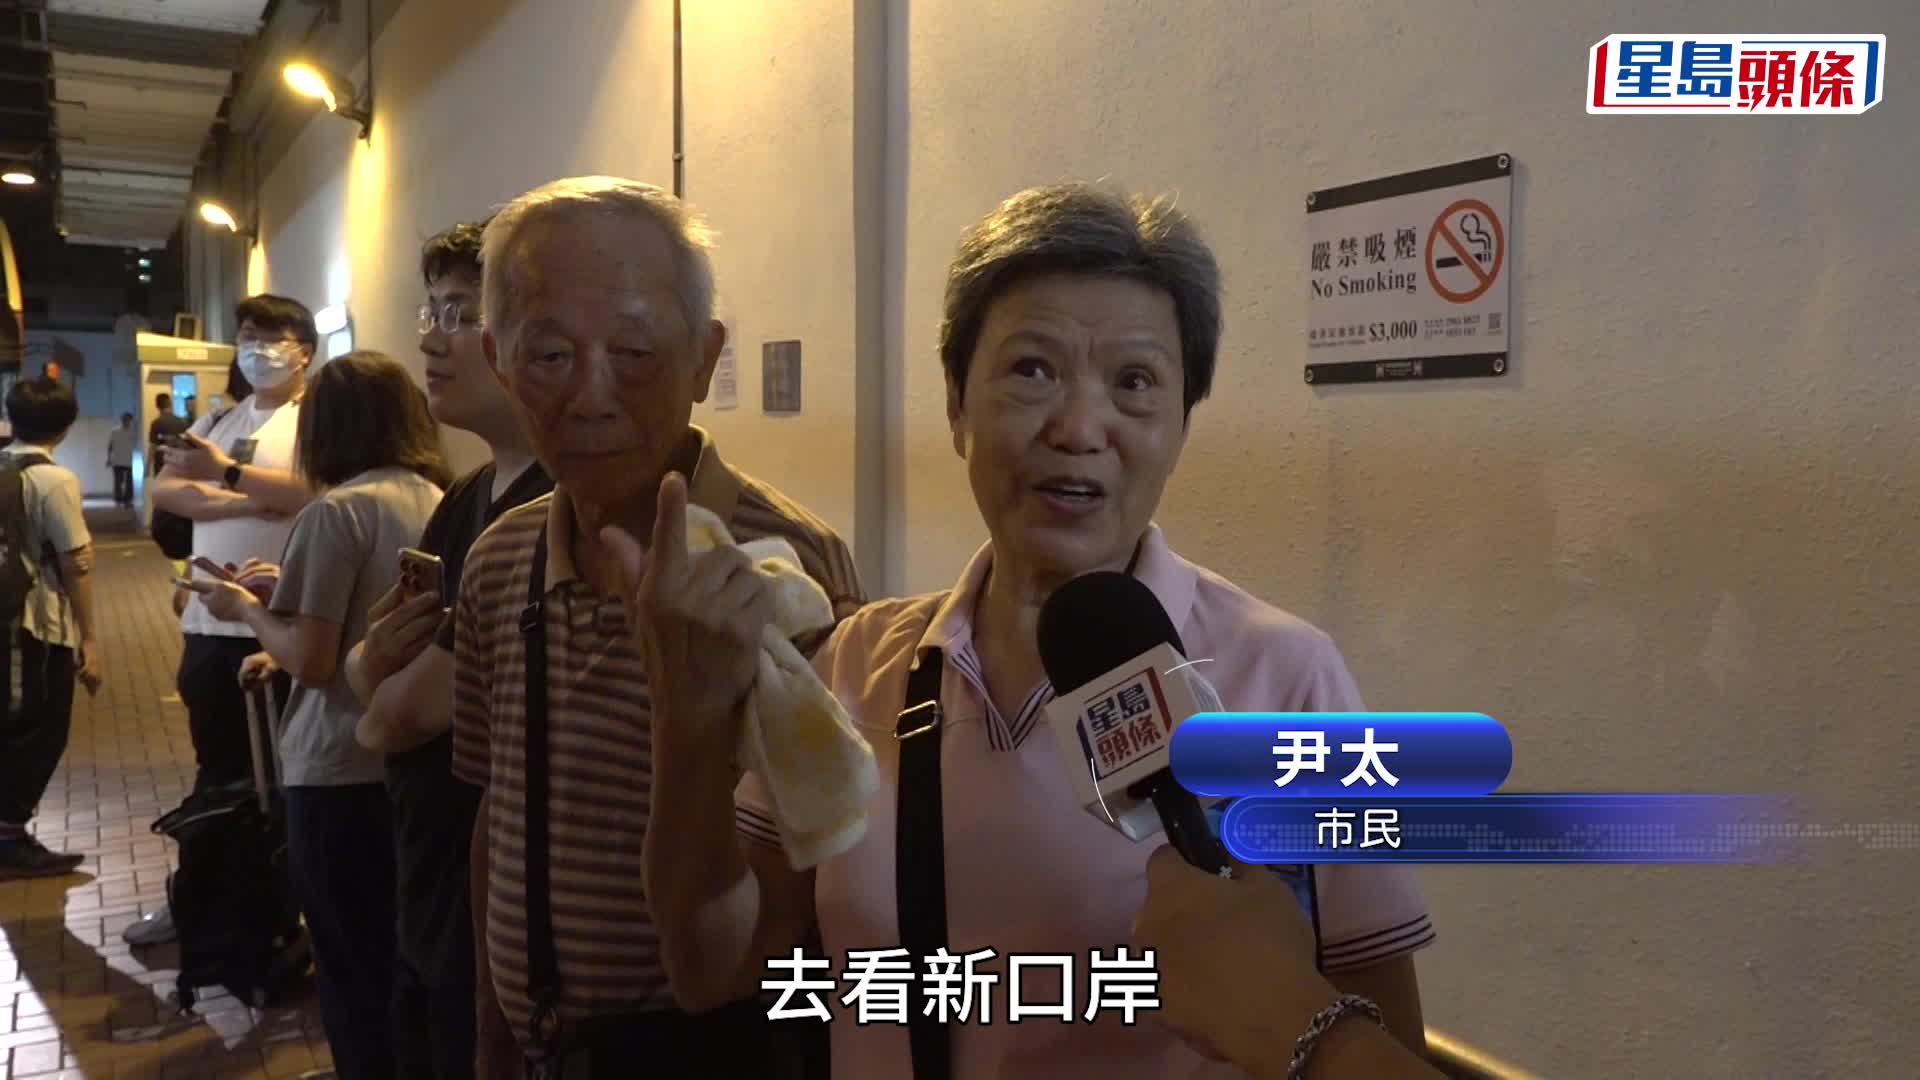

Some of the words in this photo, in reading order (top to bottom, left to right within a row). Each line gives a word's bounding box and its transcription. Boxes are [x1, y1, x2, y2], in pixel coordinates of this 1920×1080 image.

[1311, 226, 1416, 272] 嚴禁吸煙
[1311, 279, 1333, 299] No
[1338, 269, 1417, 296] Smoking
[1369, 320, 1418, 342] $3,000
[1087, 683, 1150, 737] 星島
[1097, 714, 1162, 768] 頭條
